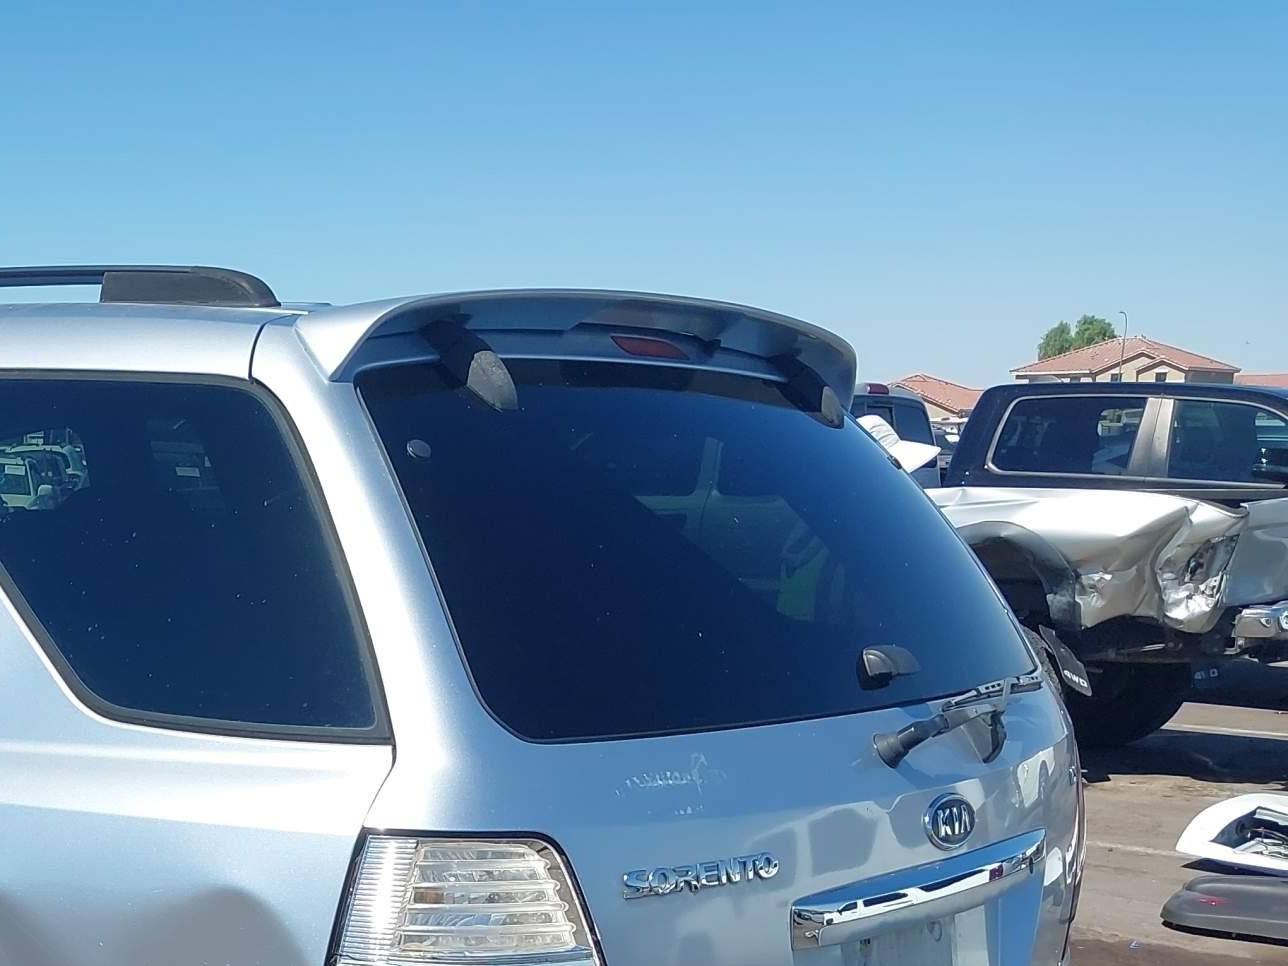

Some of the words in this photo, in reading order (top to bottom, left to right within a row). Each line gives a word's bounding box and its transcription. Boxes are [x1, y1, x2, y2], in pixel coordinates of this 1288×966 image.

[1063, 669, 1089, 688] 4WD
[1193, 668, 1219, 681] 4D
[936, 804, 971, 838] KIA
[622, 851, 780, 900] SORENTO
